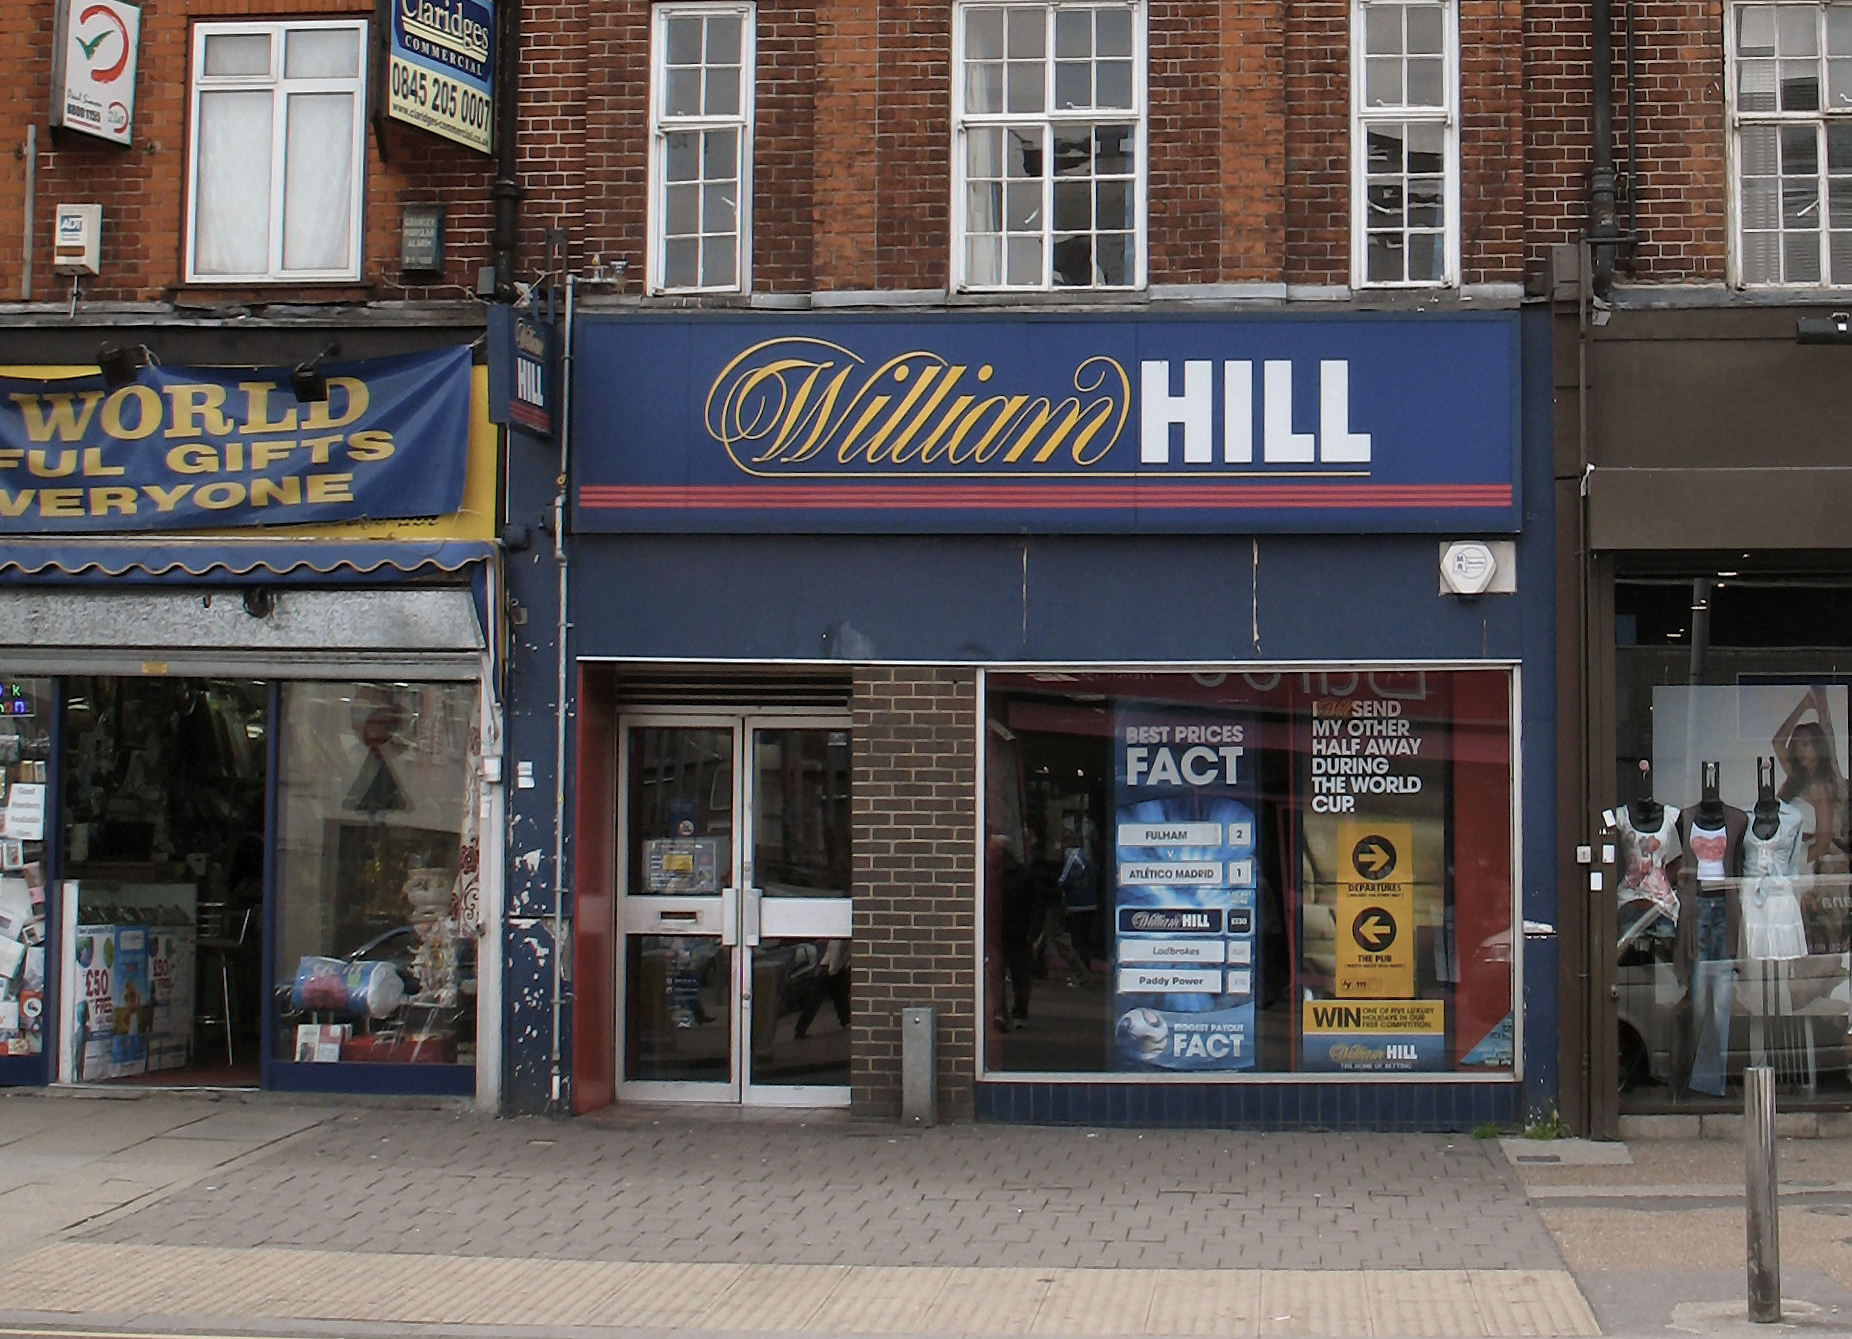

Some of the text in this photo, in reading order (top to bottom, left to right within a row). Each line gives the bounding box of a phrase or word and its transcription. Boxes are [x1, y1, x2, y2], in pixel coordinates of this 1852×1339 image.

[404, 35, 483, 76] COMMERCIAL
[392, 61, 492, 132] 0845 205 0007
[60, 217, 82, 231] ADT
[517, 357, 544, 407] HILL
[9, 376, 370, 443] WORLD
[704, 336, 1371, 465] William HILL
[166, 430, 395, 474] GIFTS
[1351, 700, 1402, 718] SEND
[1126, 725, 1244, 744] BEST PRICES
[1312, 719, 1410, 737] MY OTHER
[1312, 738, 1422, 756] HALF AWAY
[1126, 746, 1244, 786] FACT
[1312, 757, 1390, 775] DURING
[1312, 776, 1422, 794] THE WORLD
[1312, 795, 1355, 813] CUP.
[1145, 830, 1243, 841] FULHAM 2
[1129, 866, 1215, 880] ATLÉTICO MADRID
[1237, 868, 1242, 878] 1
[1348, 883, 1402, 892] DEPARTURES
[1131, 912, 1210, 929] William HILL
[1152, 946, 1200, 956] Ladbrokes
[1357, 955, 1392, 963] THE PUB
[85, 969, 109, 998] £50
[1139, 977, 1204, 986] Paddy Power
[1312, 1006, 1361, 1028] WIN
[1173, 1033, 1245, 1058] FACT
[1386, 1045, 1417, 1059] HILL
